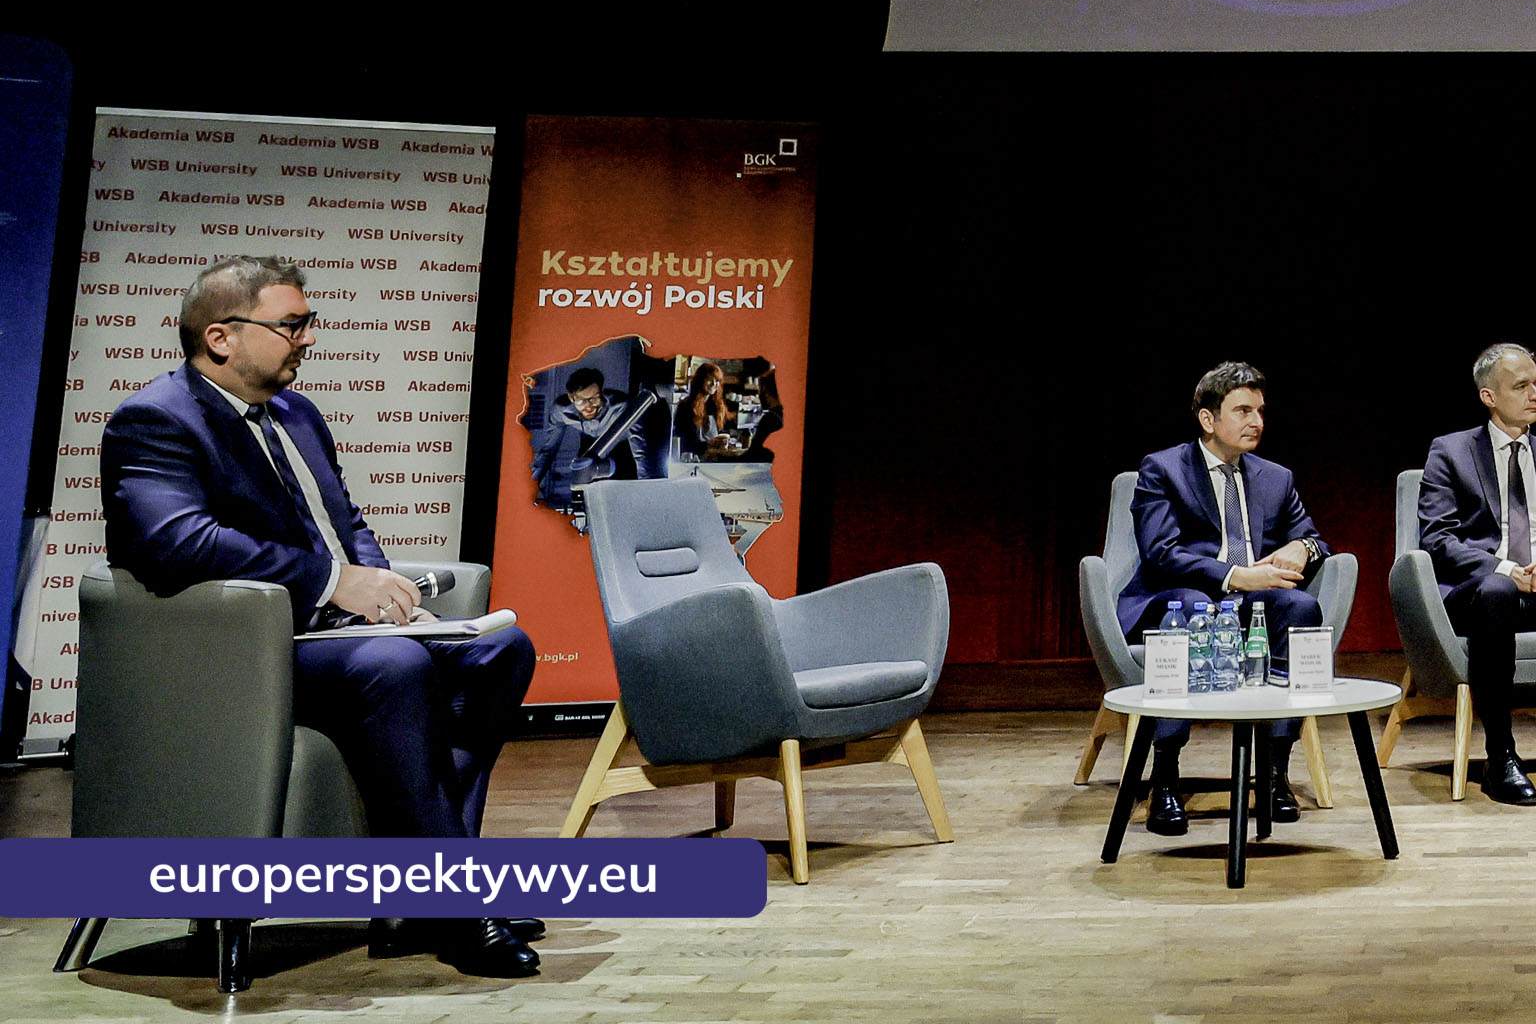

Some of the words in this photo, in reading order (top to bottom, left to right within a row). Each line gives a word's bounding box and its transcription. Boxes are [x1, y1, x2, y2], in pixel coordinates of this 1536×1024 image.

[108, 127, 189, 142] Akademia
[196, 130, 235, 144] WSB
[258, 134, 336, 148] Akademia
[342, 137, 379, 150] WSB
[402, 141, 475, 156] Akademia
[744, 153, 777, 166] BGK
[131, 159, 169, 171] WSB
[176, 161, 257, 176] University
[281, 165, 317, 177] WSB
[324, 167, 401, 183] University
[423, 172, 457, 183] WSB
[95, 189, 134, 201] WSB
[158, 190, 240, 205] Akademia
[247, 194, 285, 206] WSB
[308, 196, 385, 210] Akademia
[391, 199, 427, 211] WSB
[93, 221, 176, 235] University
[202, 224, 239, 235] WSB
[245, 225, 325, 240] University
[348, 228, 383, 240] WSB
[390, 230, 464, 245] University
[124, 252, 207, 265] Akademia
[361, 259, 397, 270] WSB
[541, 249, 794, 288] Kształtujemy
[81, 284, 119, 295] WSB
[380, 289, 415, 301] WSB
[538, 282, 653, 315] rozwój
[664, 284, 764, 309] Polski
[96, 315, 136, 327] WSB
[311, 319, 388, 331] Akademia
[394, 320, 431, 331] WSB
[105, 347, 144, 359] WSB
[303, 349, 380, 363] University
[403, 351, 438, 361] WSB
[348, 380, 385, 392] WSB
[377, 411, 413, 423] WSB
[335, 441, 411, 454] Akademia
[416, 441, 453, 453] WSB
[370, 473, 405, 484] WSB
[415, 503, 451, 514] WSB
